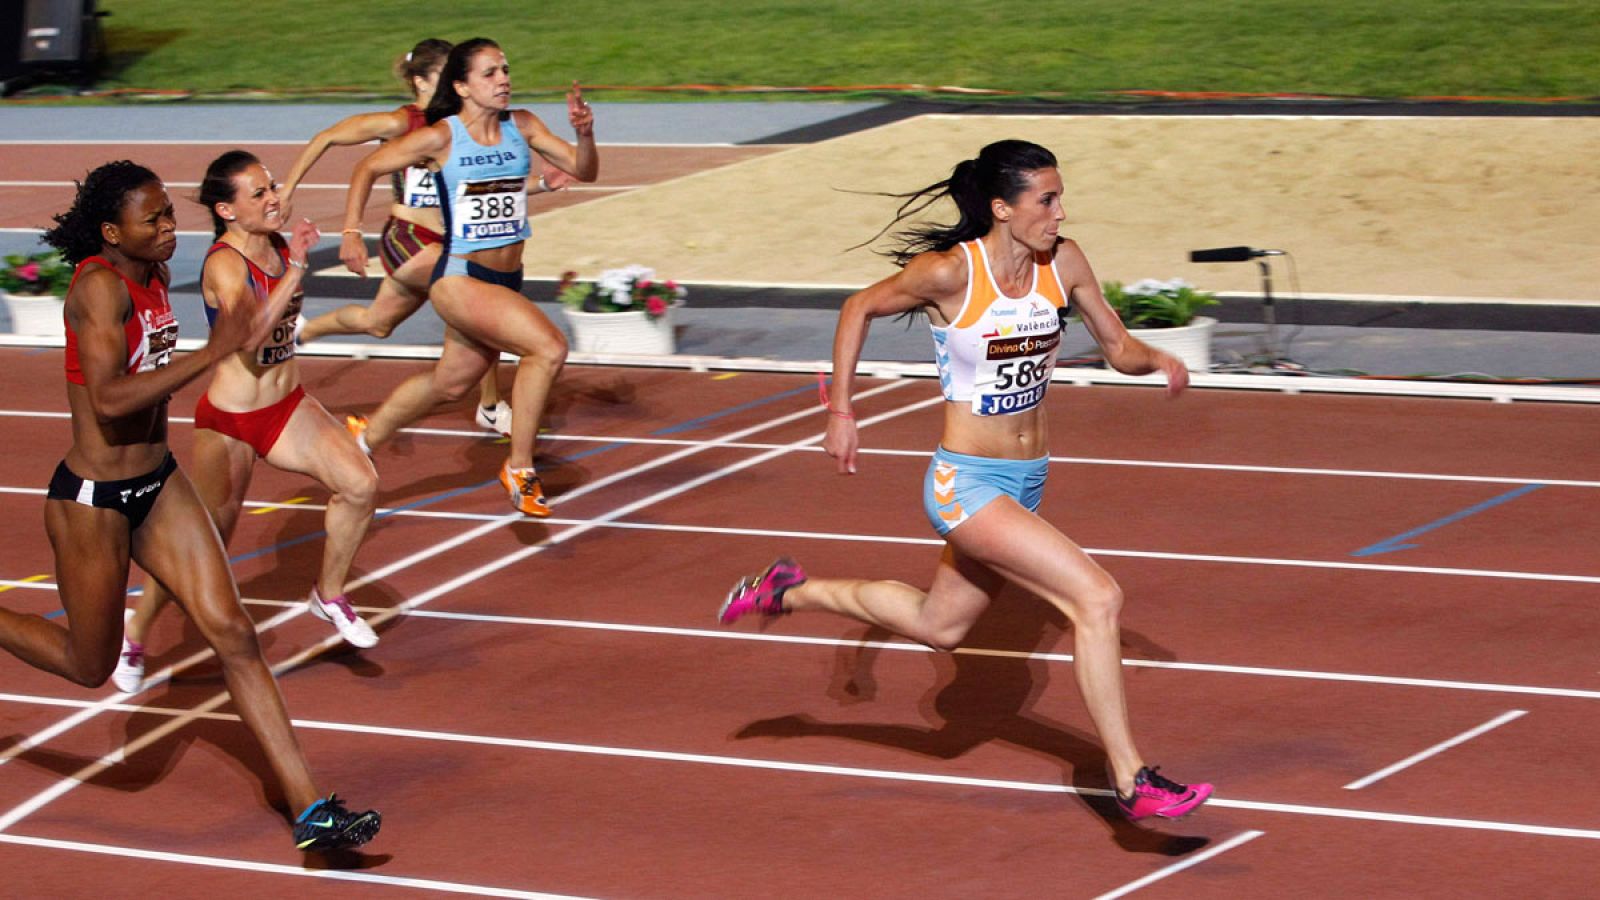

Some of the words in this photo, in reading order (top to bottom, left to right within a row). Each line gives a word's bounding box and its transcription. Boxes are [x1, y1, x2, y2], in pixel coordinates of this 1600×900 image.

[459, 150, 516, 167] nerja
[470, 196, 515, 220] 388
[989, 344, 1018, 355] Divina
[995, 355, 1049, 390] 586
